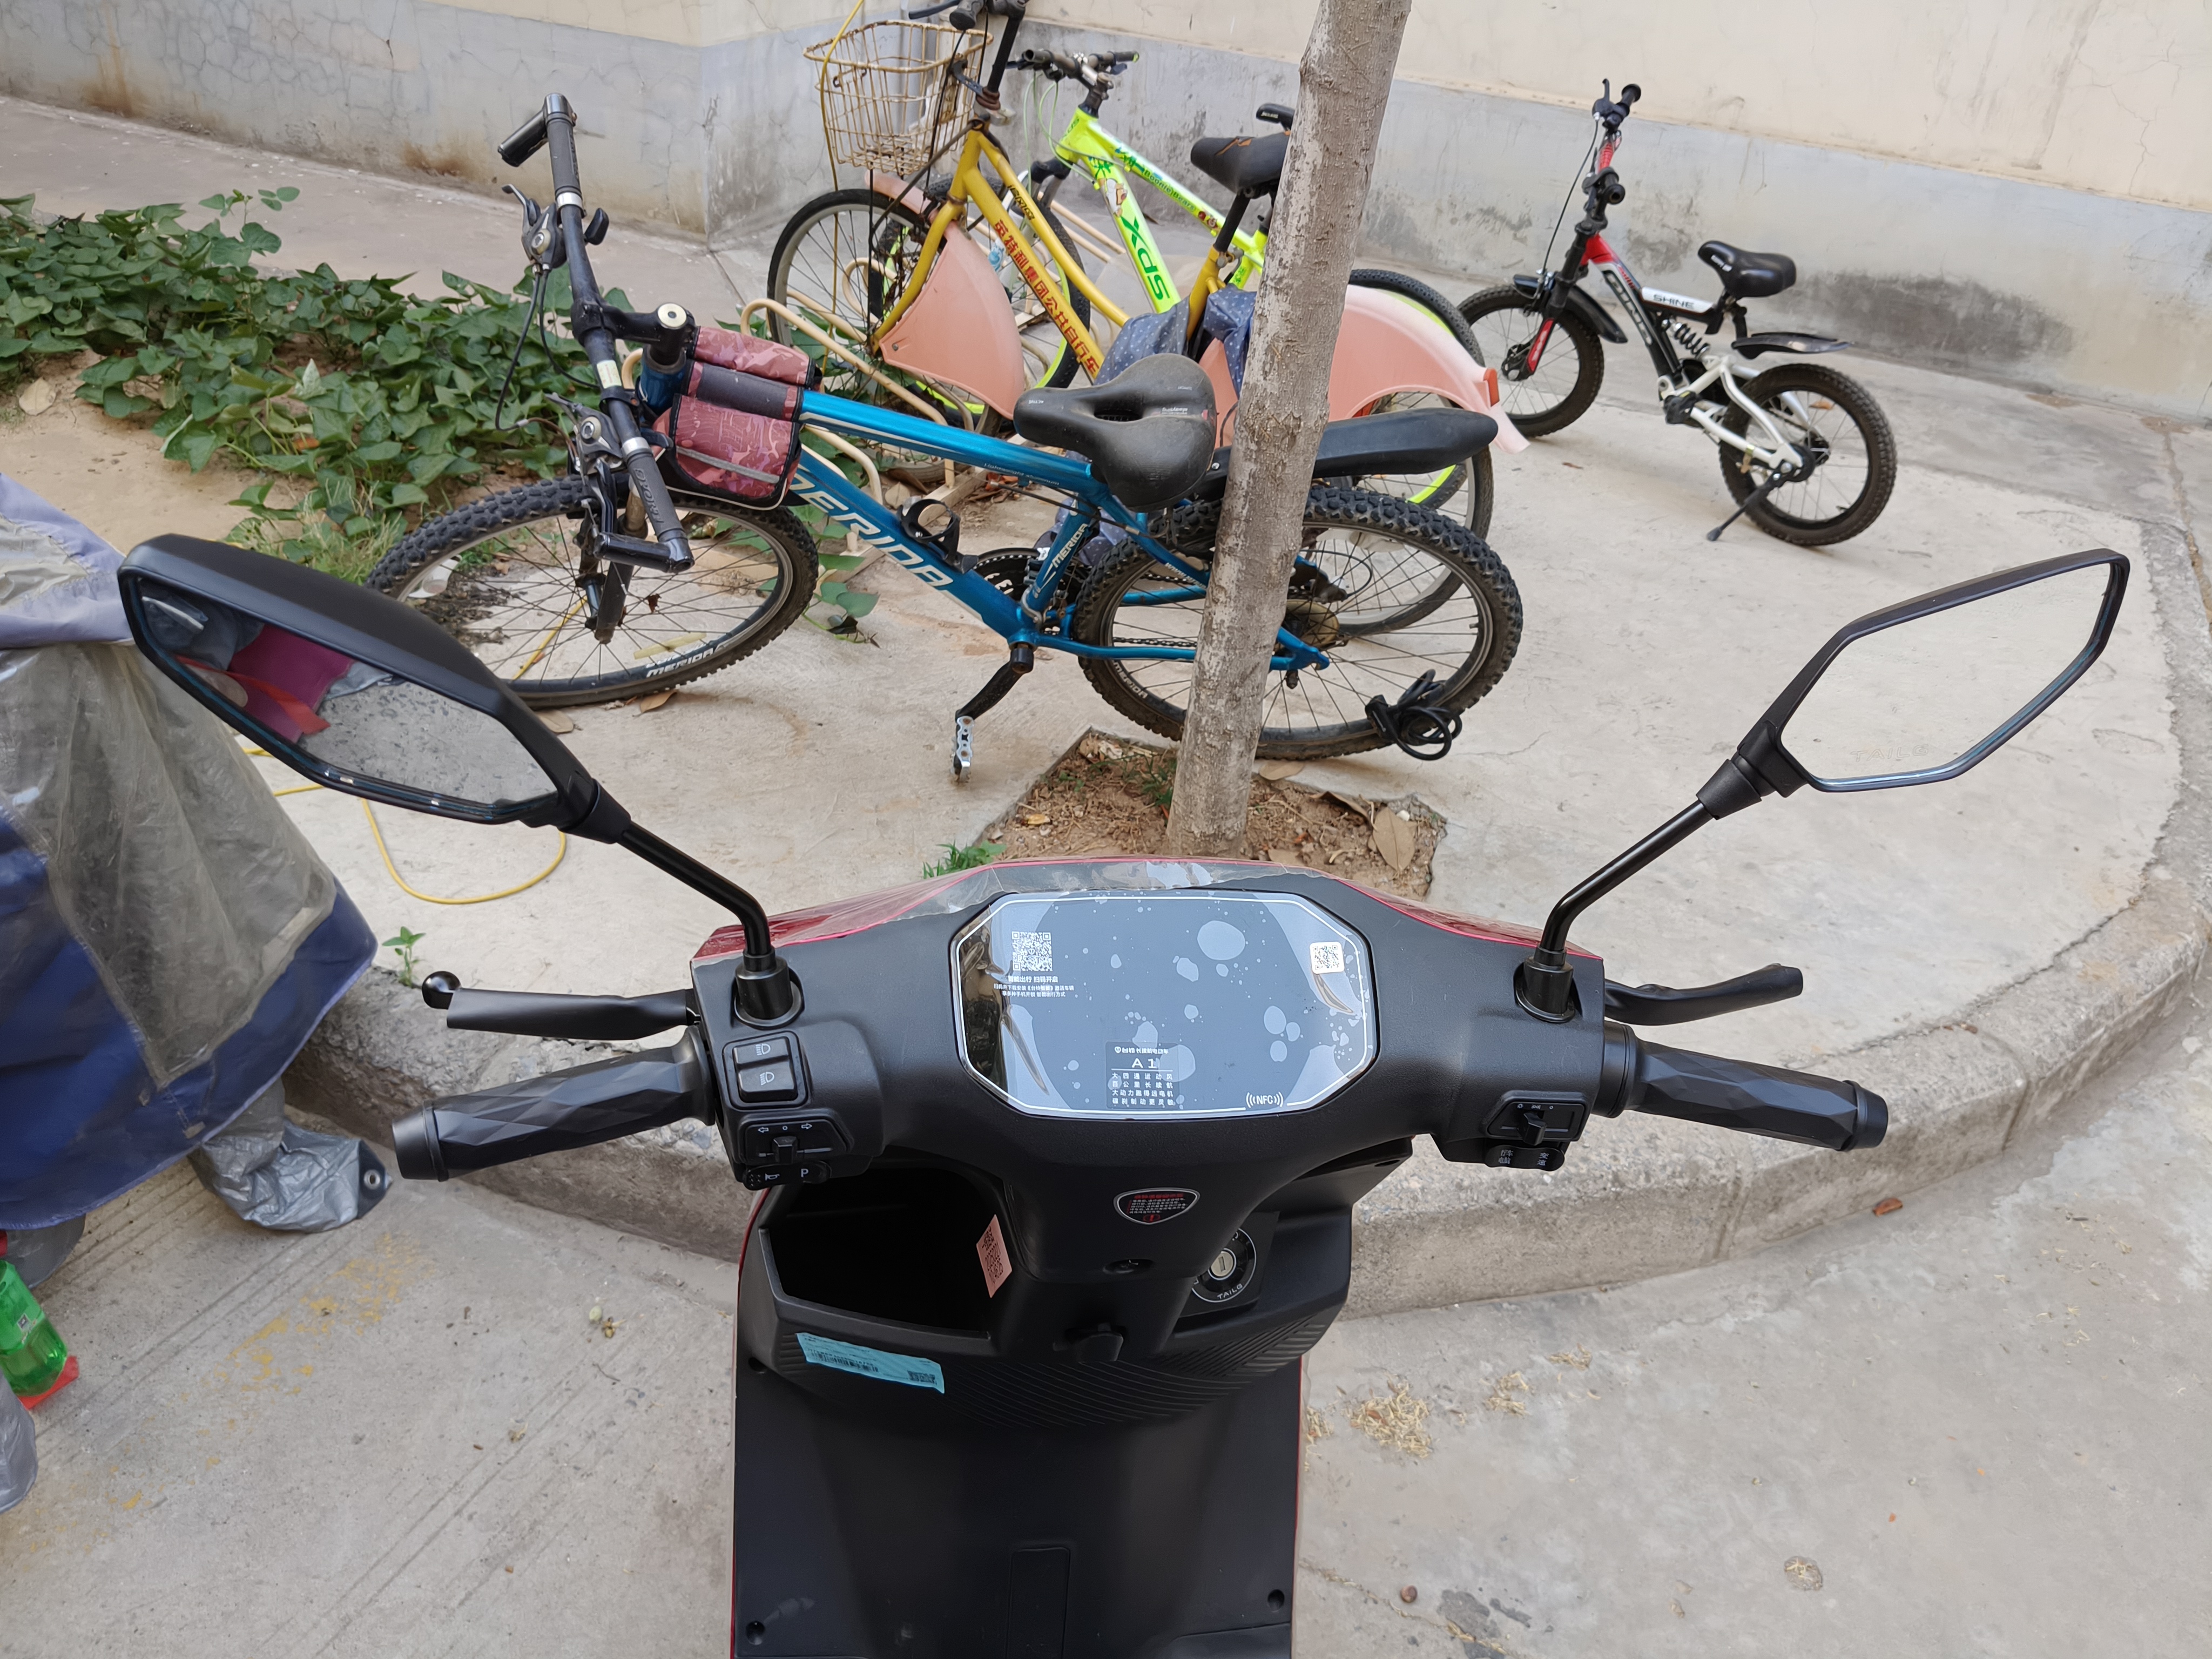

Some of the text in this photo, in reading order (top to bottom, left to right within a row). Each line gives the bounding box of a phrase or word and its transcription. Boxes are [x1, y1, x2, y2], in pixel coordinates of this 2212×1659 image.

[1143, 170, 1196, 211] Boonie Bears
[994, 219, 1100, 375] 英特利集团公共自行车
[1653, 294, 1694, 309] SHINE
[1051, 523, 1088, 568] MERIDA
[646, 648, 714, 678] MERIDA
[1114, 662, 1148, 699] MERIDA
[1850, 744, 1929, 763] TAILG
[1256, 1095, 1273, 1105] NFC
[800, 1168, 809, 1178] P
[1217, 1283, 1243, 1300] TAILG
